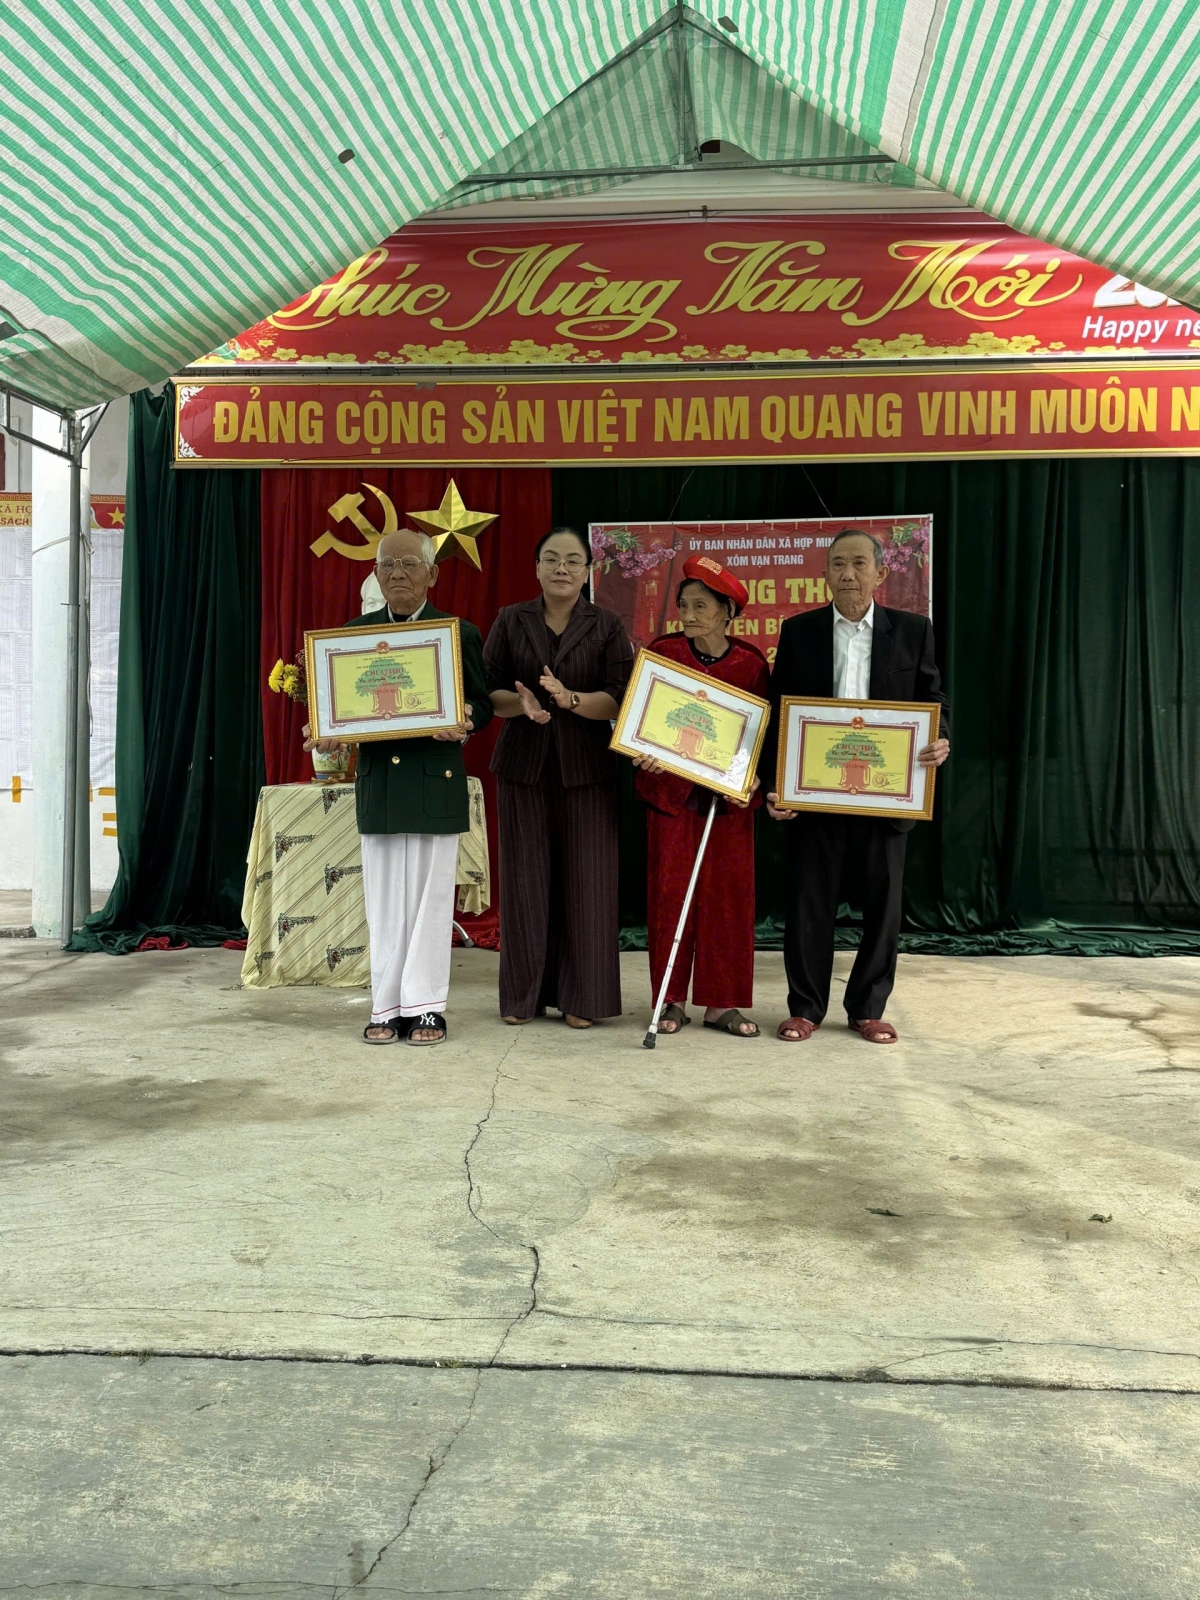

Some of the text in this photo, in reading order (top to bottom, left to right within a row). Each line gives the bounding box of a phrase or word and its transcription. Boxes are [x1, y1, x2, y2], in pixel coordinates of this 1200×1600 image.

[430, 242, 683, 343] Mừng
[686, 240, 864, 315] Năm
[841, 238, 1083, 328] Mới
[1082, 315, 1200, 344] Happy ne
[213, 386, 324, 445] ĐẢNG
[336, 390, 447, 454] CỘNG
[461, 385, 545, 445] SẢN
[558, 389, 643, 453] VIỆT
[653, 395, 750, 442] NAM
[760, 392, 903, 444] QUANG
[918, 390, 1017, 437] VINH
[1030, 376, 1157, 435] MUÔN
[0, 516, 29, 526] SÁCH
[689, 536, 835, 552] ỦY BAN NHÂN DÂN XÃ HỢP MIN
[727, 554, 804, 568] XÓM VẠN TRANG
